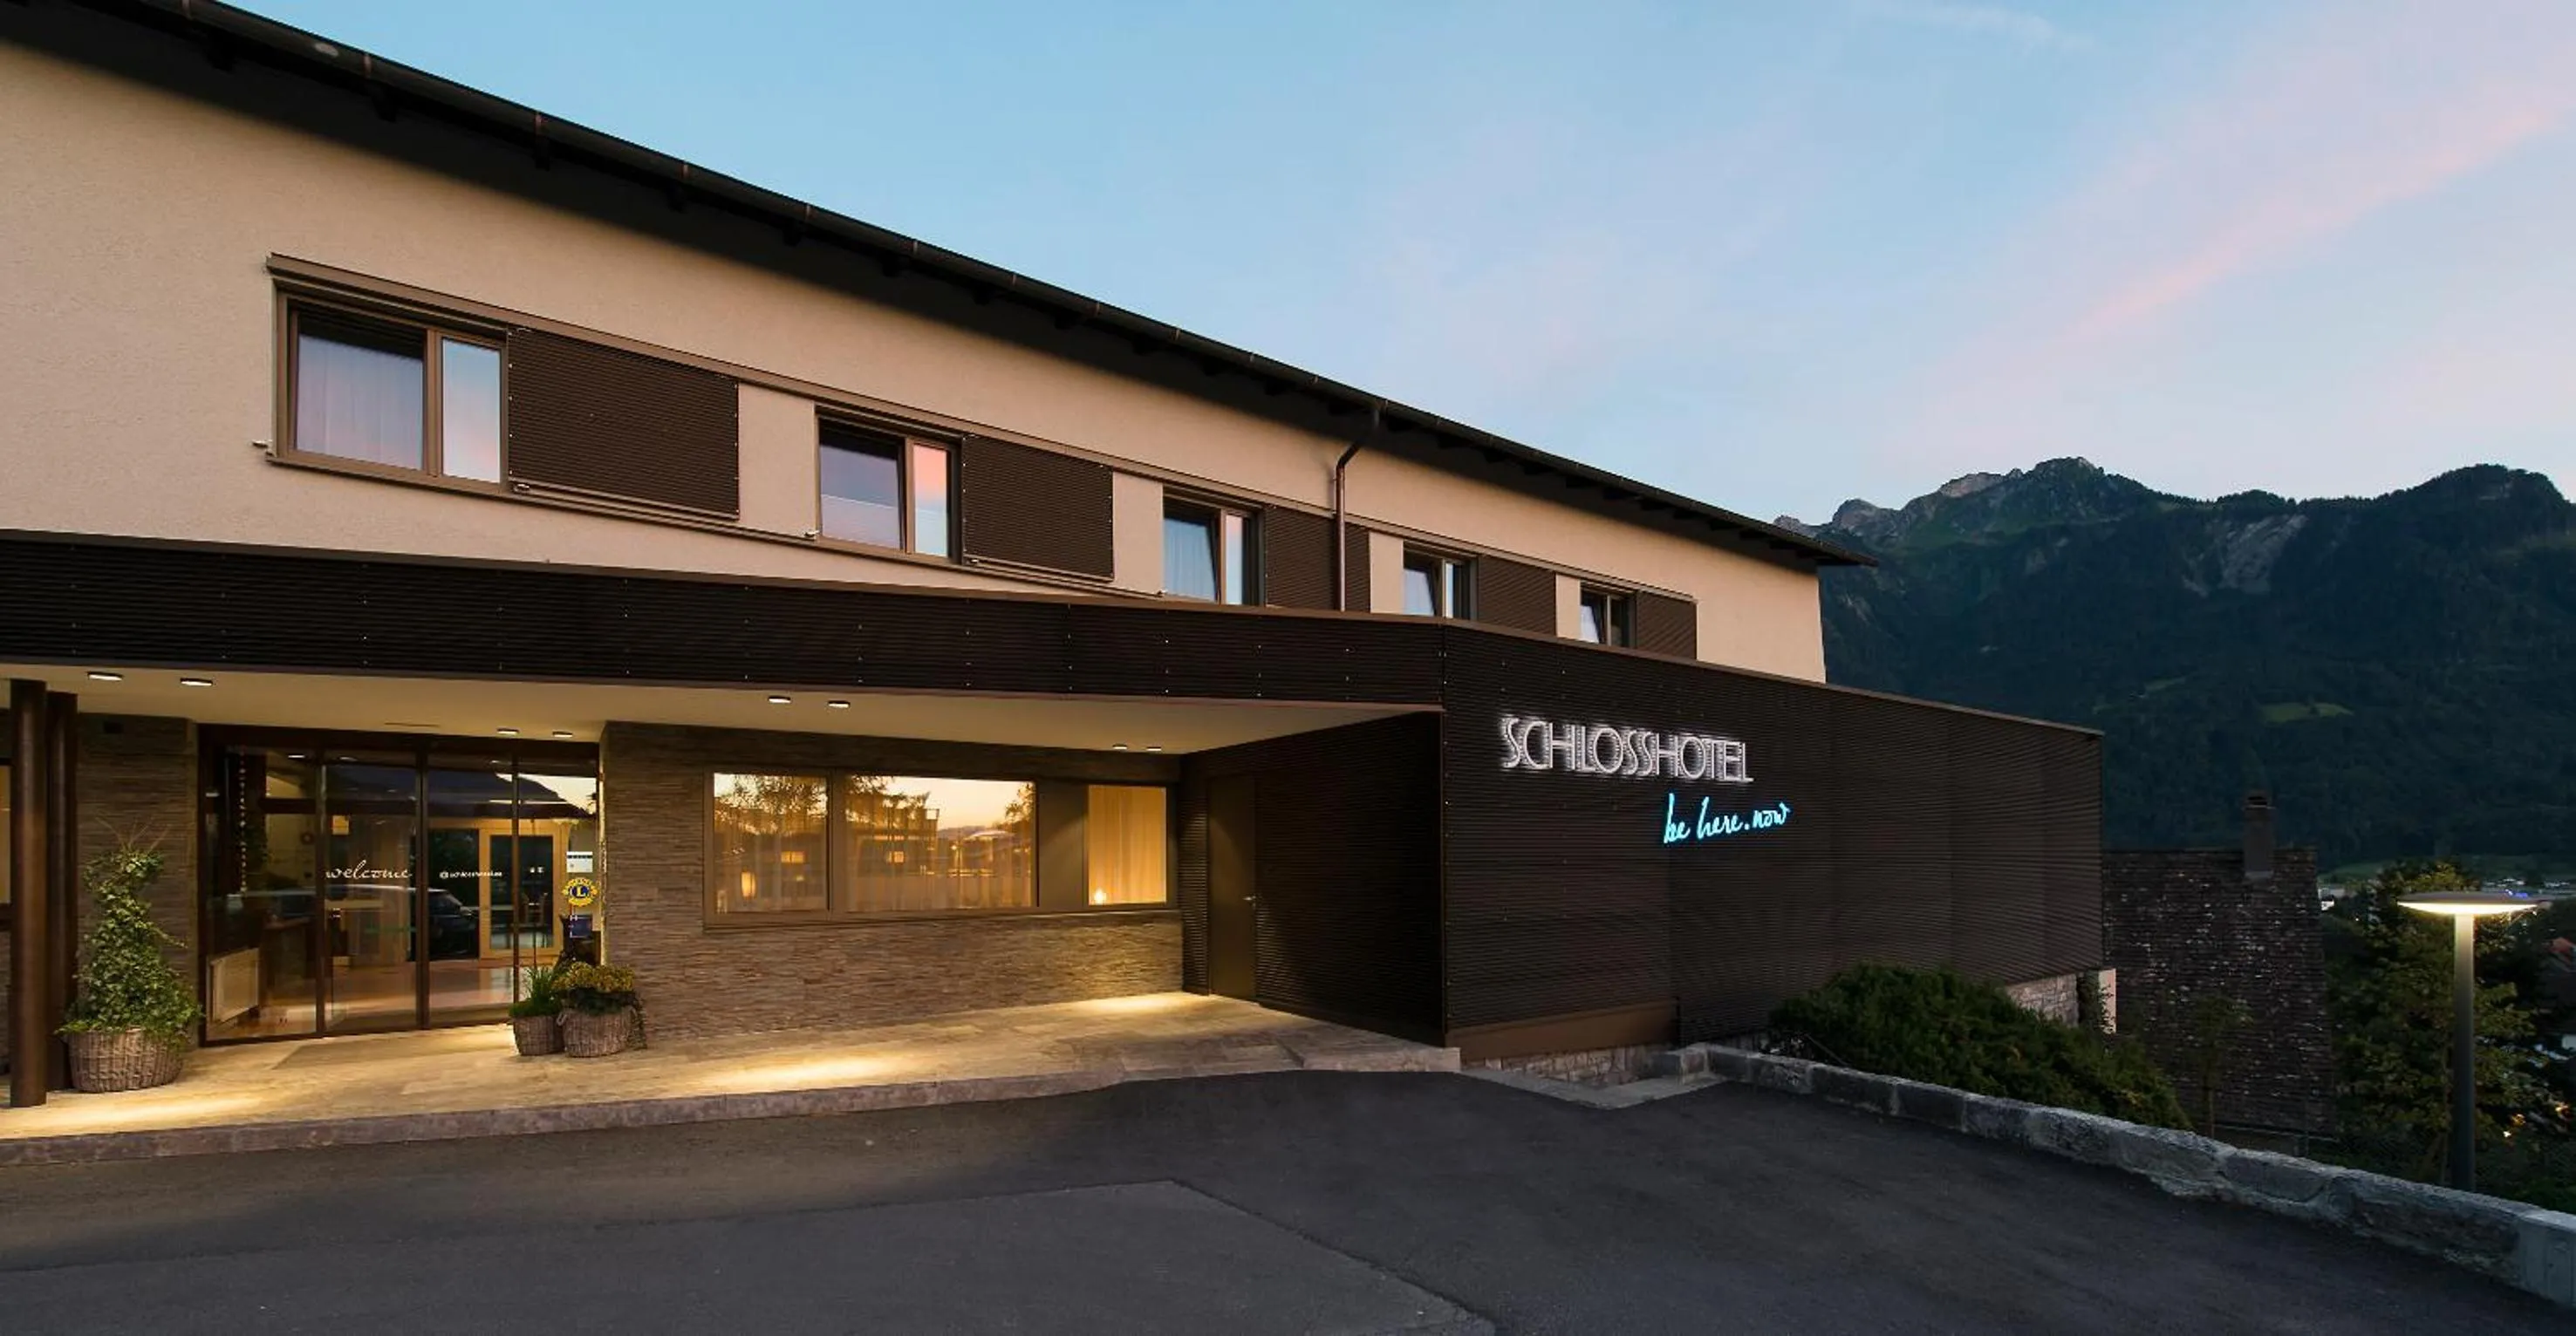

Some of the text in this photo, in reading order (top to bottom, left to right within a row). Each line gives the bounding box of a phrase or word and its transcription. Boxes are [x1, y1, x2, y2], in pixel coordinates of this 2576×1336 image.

[1500, 714, 1754, 783] SCHLOSSHOTEL
[1664, 793, 1691, 843] be
[326, 859, 413, 879] welcome
